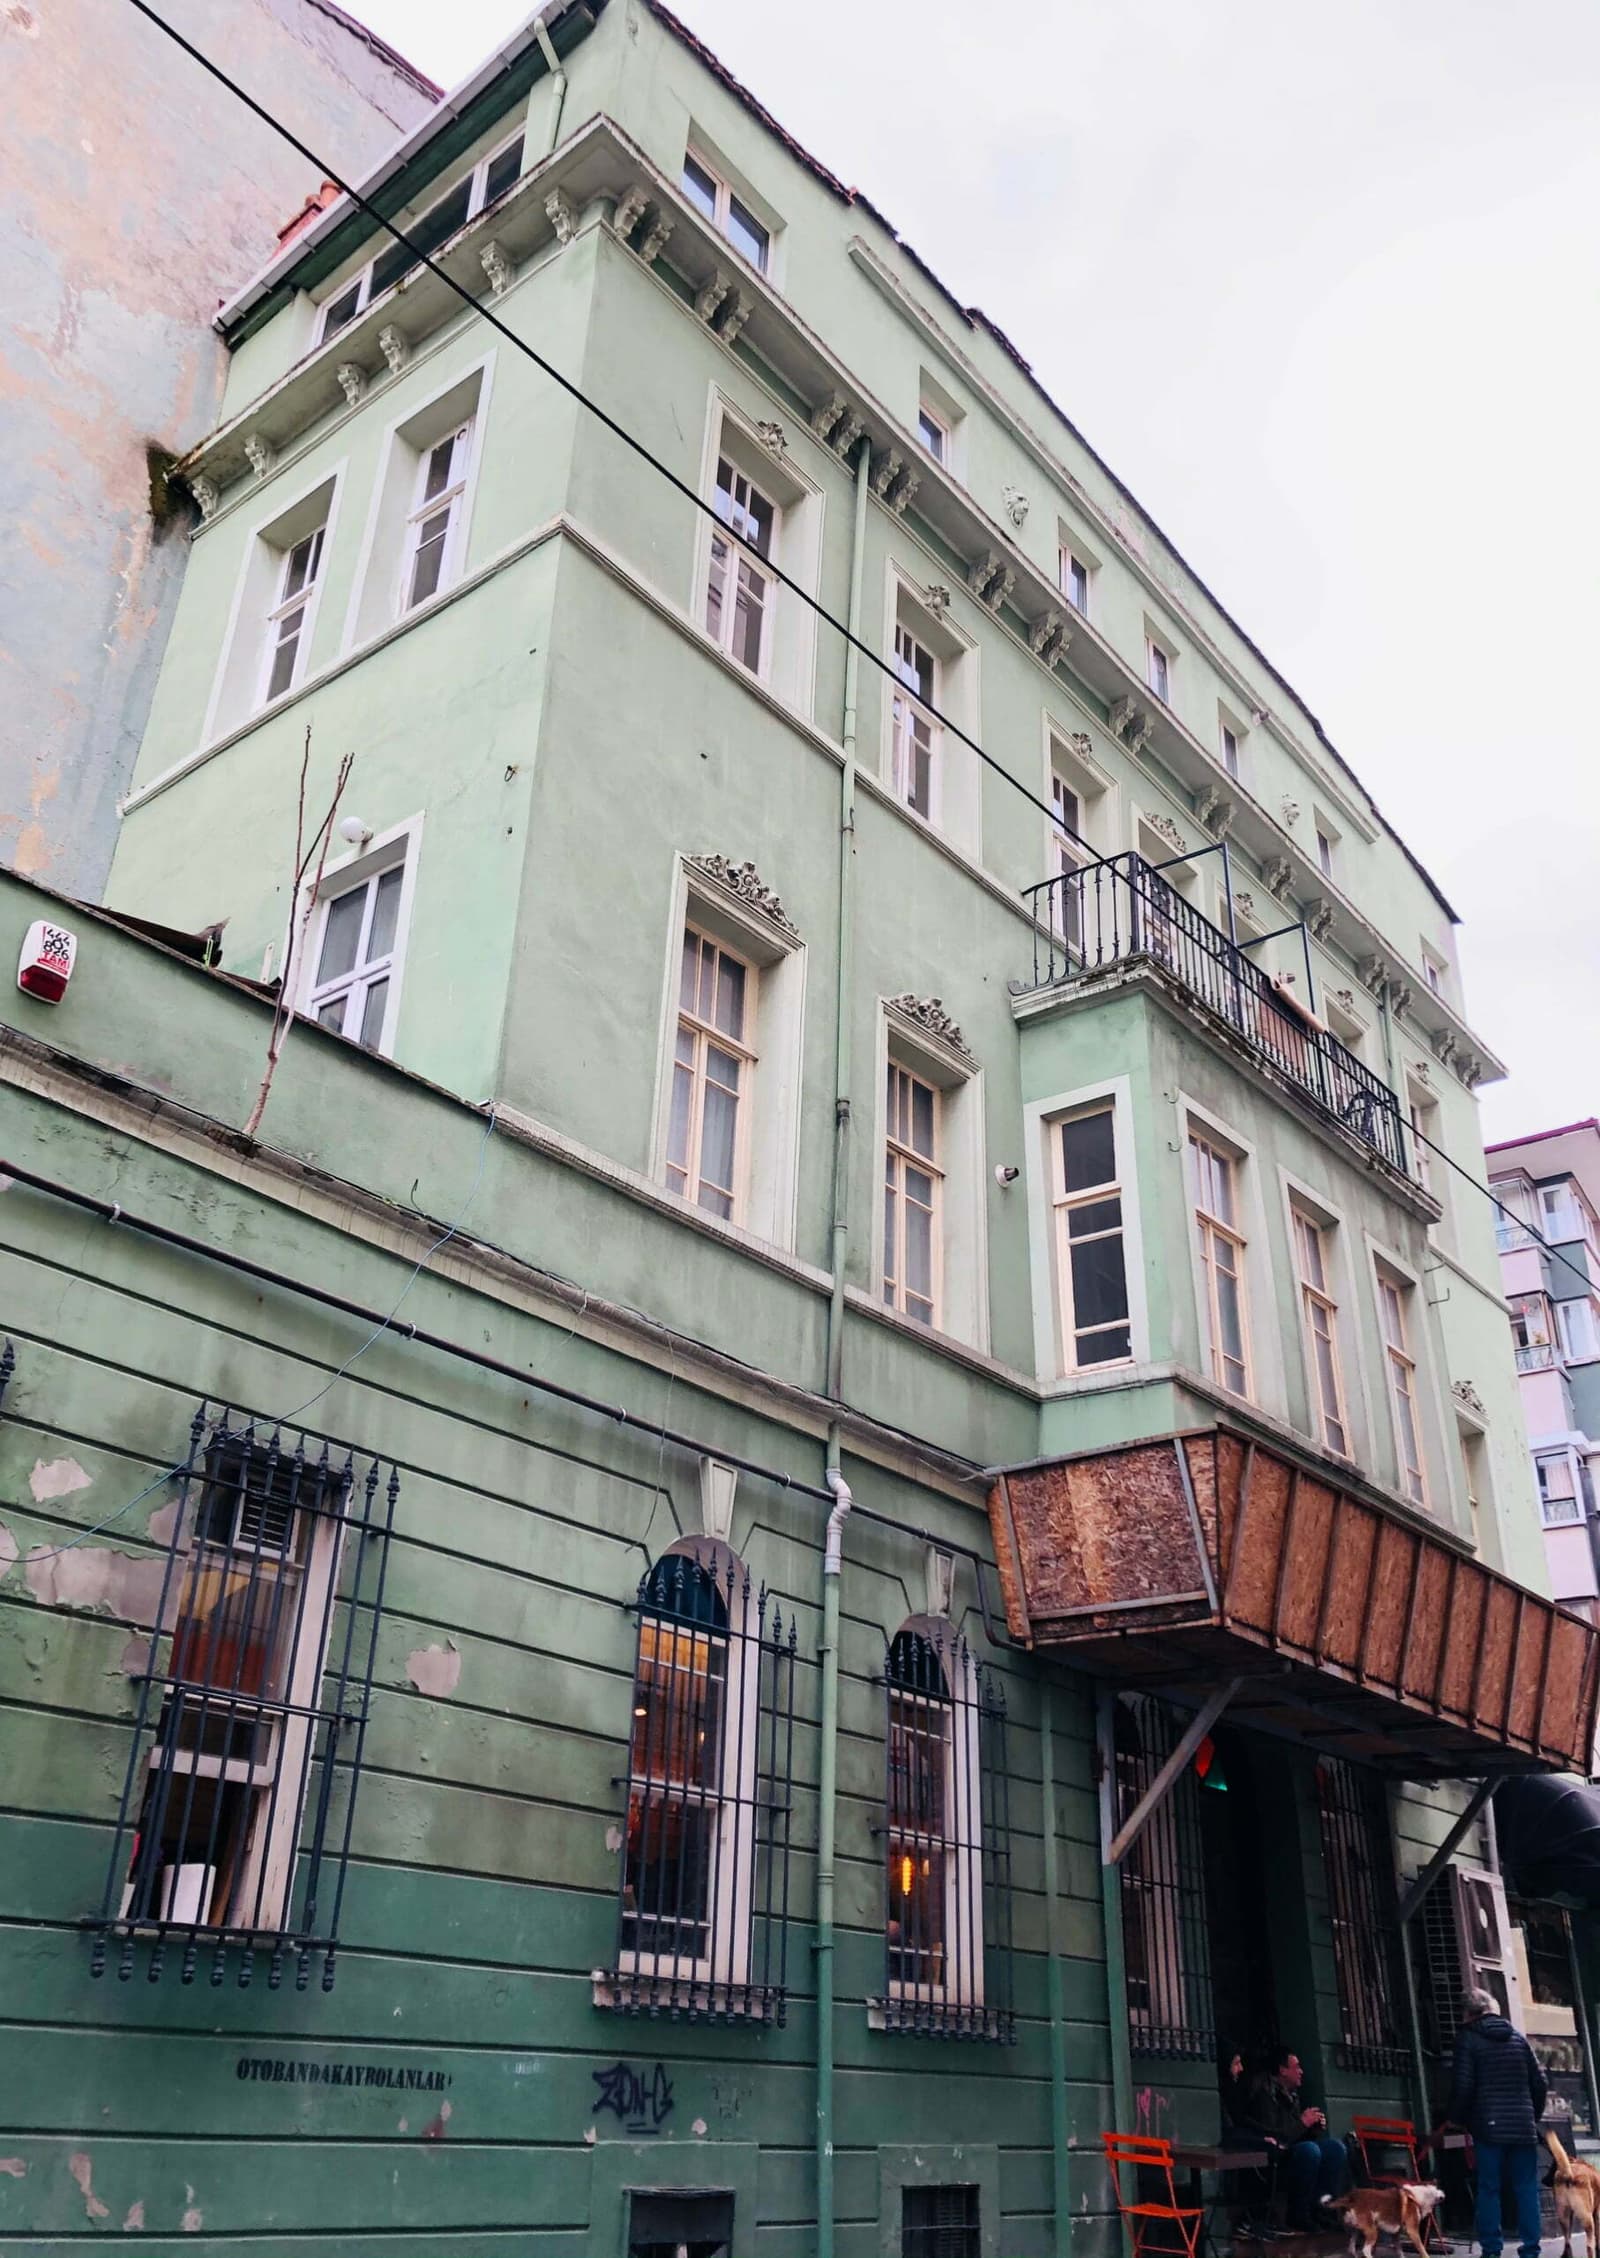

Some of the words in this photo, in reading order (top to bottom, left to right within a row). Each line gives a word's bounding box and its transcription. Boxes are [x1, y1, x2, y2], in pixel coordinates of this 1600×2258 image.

[47, 928, 70, 946] 444
[43, 940, 70, 960] 826
[43, 951, 67, 968] TAM
